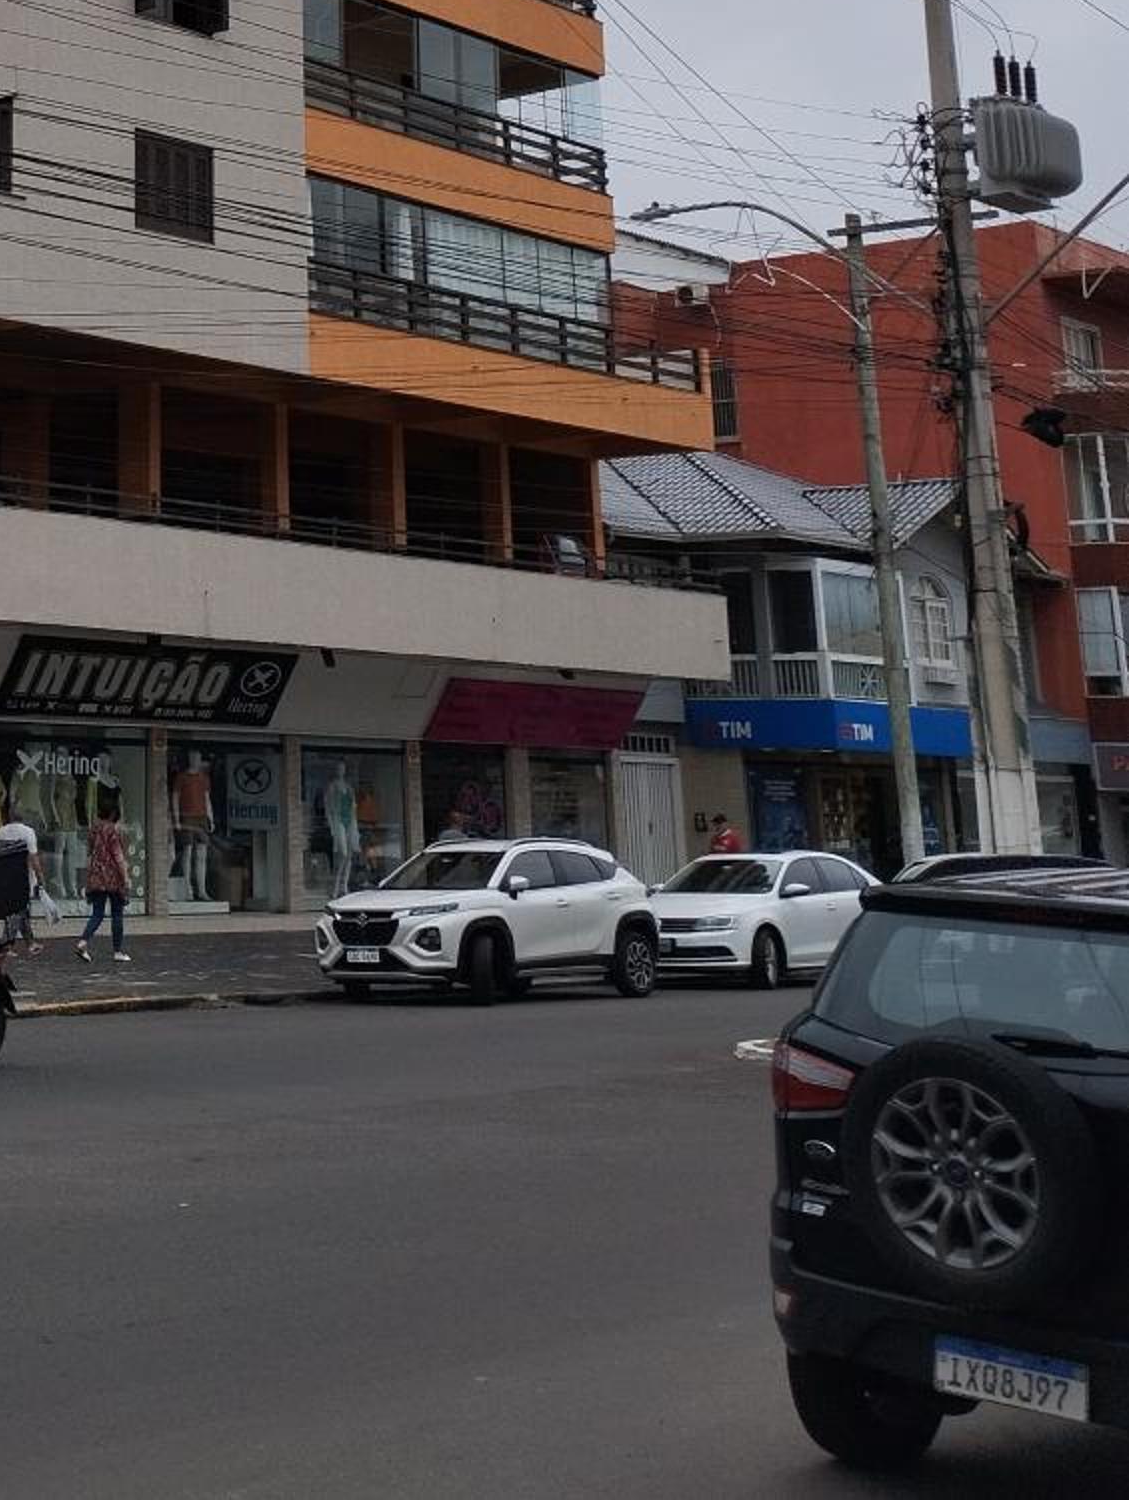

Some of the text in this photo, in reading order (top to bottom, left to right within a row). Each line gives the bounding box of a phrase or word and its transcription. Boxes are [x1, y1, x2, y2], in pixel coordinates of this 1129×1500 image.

[12, 651, 232, 708] INTUIÇÃO
[228, 697, 269, 719] Hering
[719, 721, 752, 739] TIM
[852, 724, 874, 741] TIM
[44, 751, 102, 776] Hering
[228, 802, 279, 825] Hering
[948, 1357, 1069, 1411] IXQ8J97
